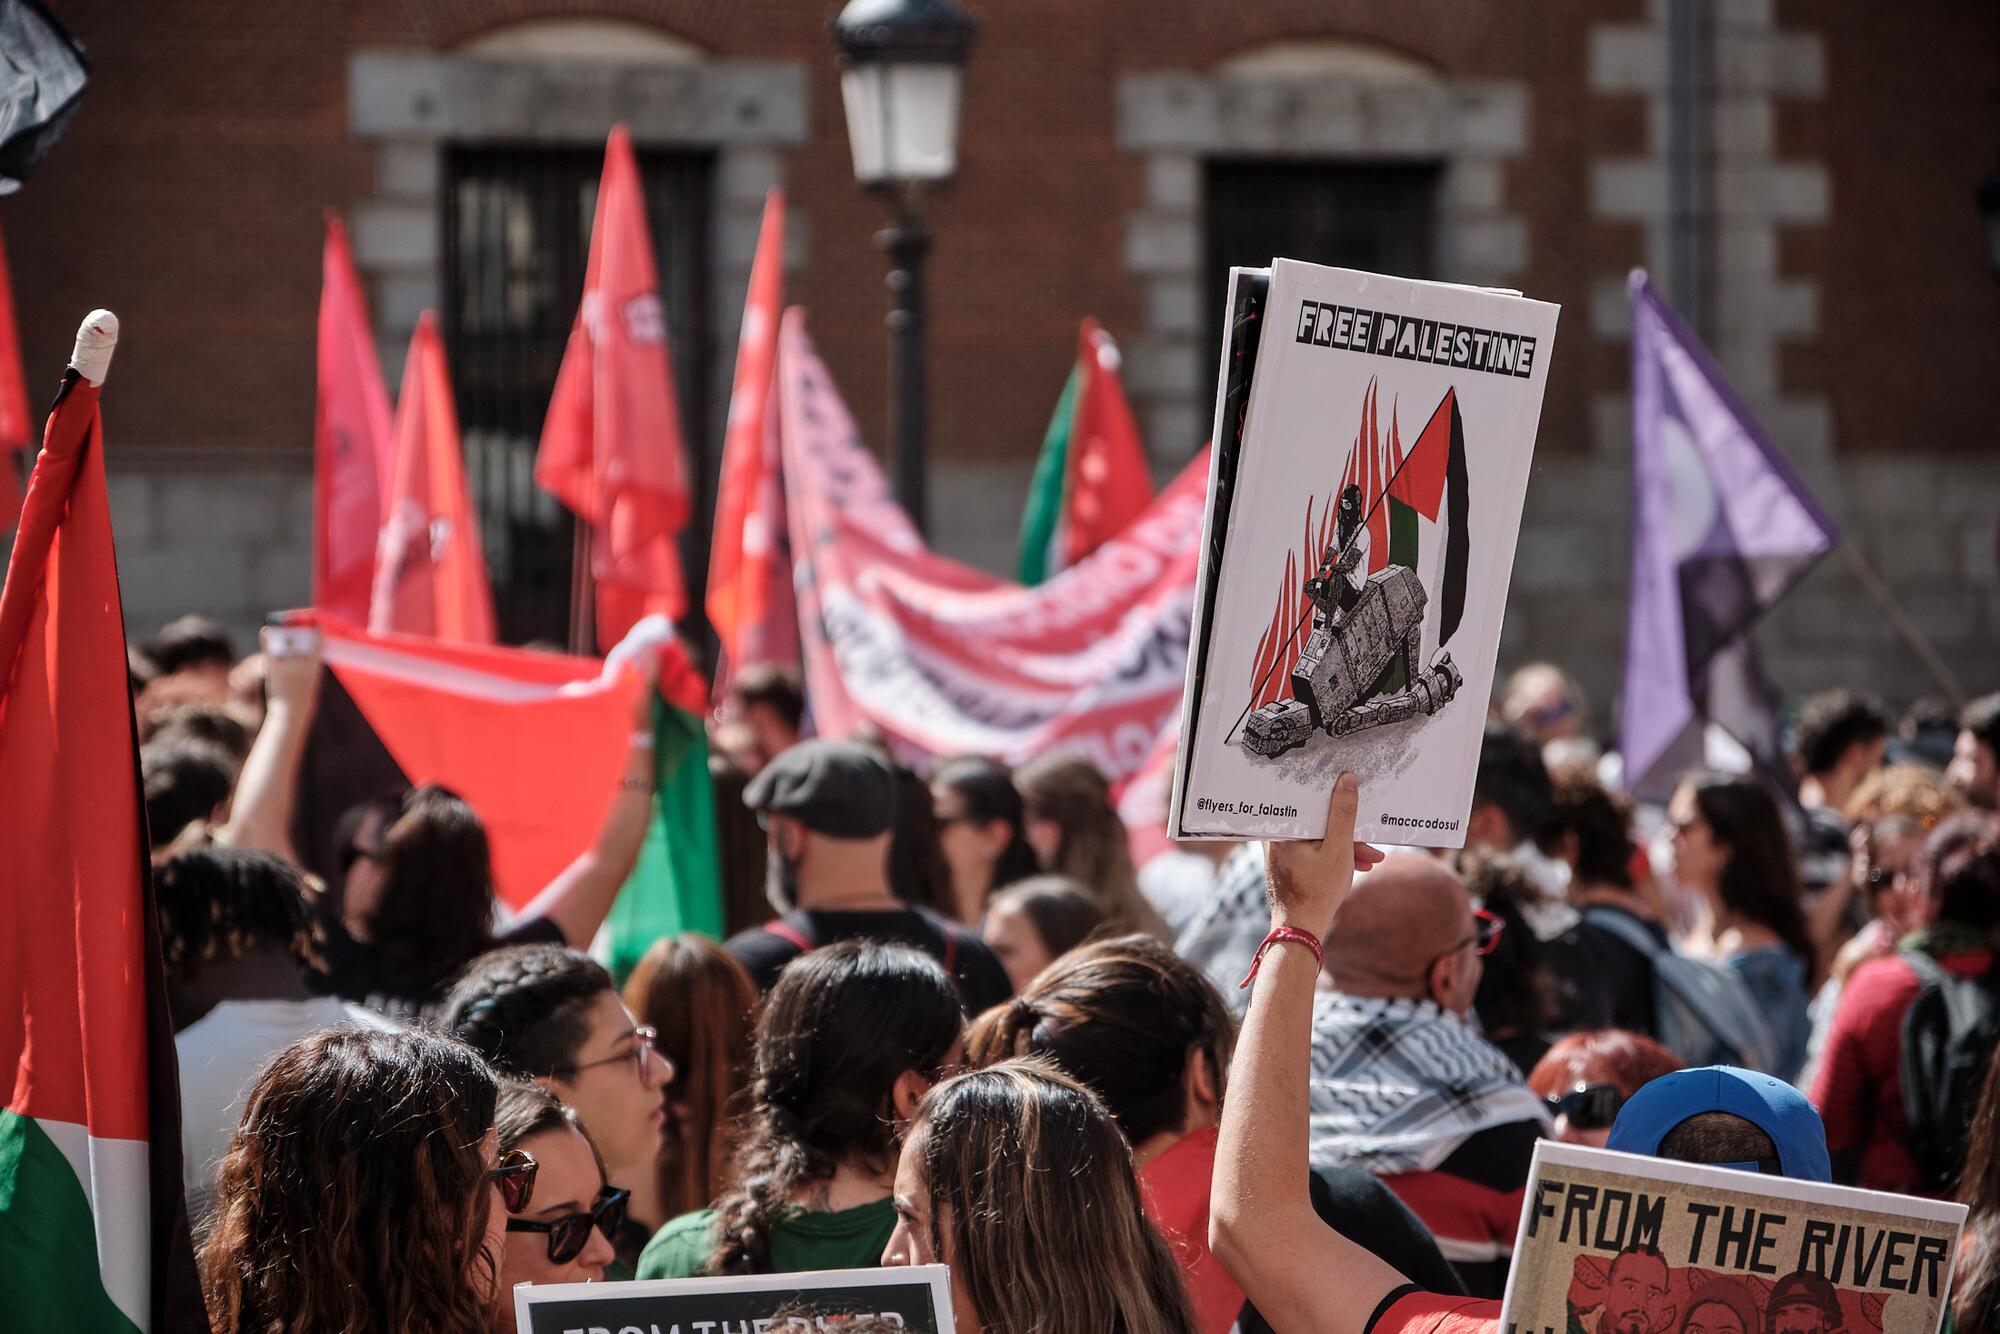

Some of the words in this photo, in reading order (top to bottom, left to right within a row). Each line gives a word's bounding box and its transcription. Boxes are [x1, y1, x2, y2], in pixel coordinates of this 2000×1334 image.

[1297, 302, 1373, 350] FREE
[1377, 314, 1536, 376] PALESTINE
[1196, 797, 1298, 818] @flyers_for_falastin
[1380, 813, 1460, 831] @macacodosul
[1528, 1179, 1666, 1256] FROM
[1687, 1202, 1787, 1275] THE
[1797, 1219, 1949, 1298] RIVER
